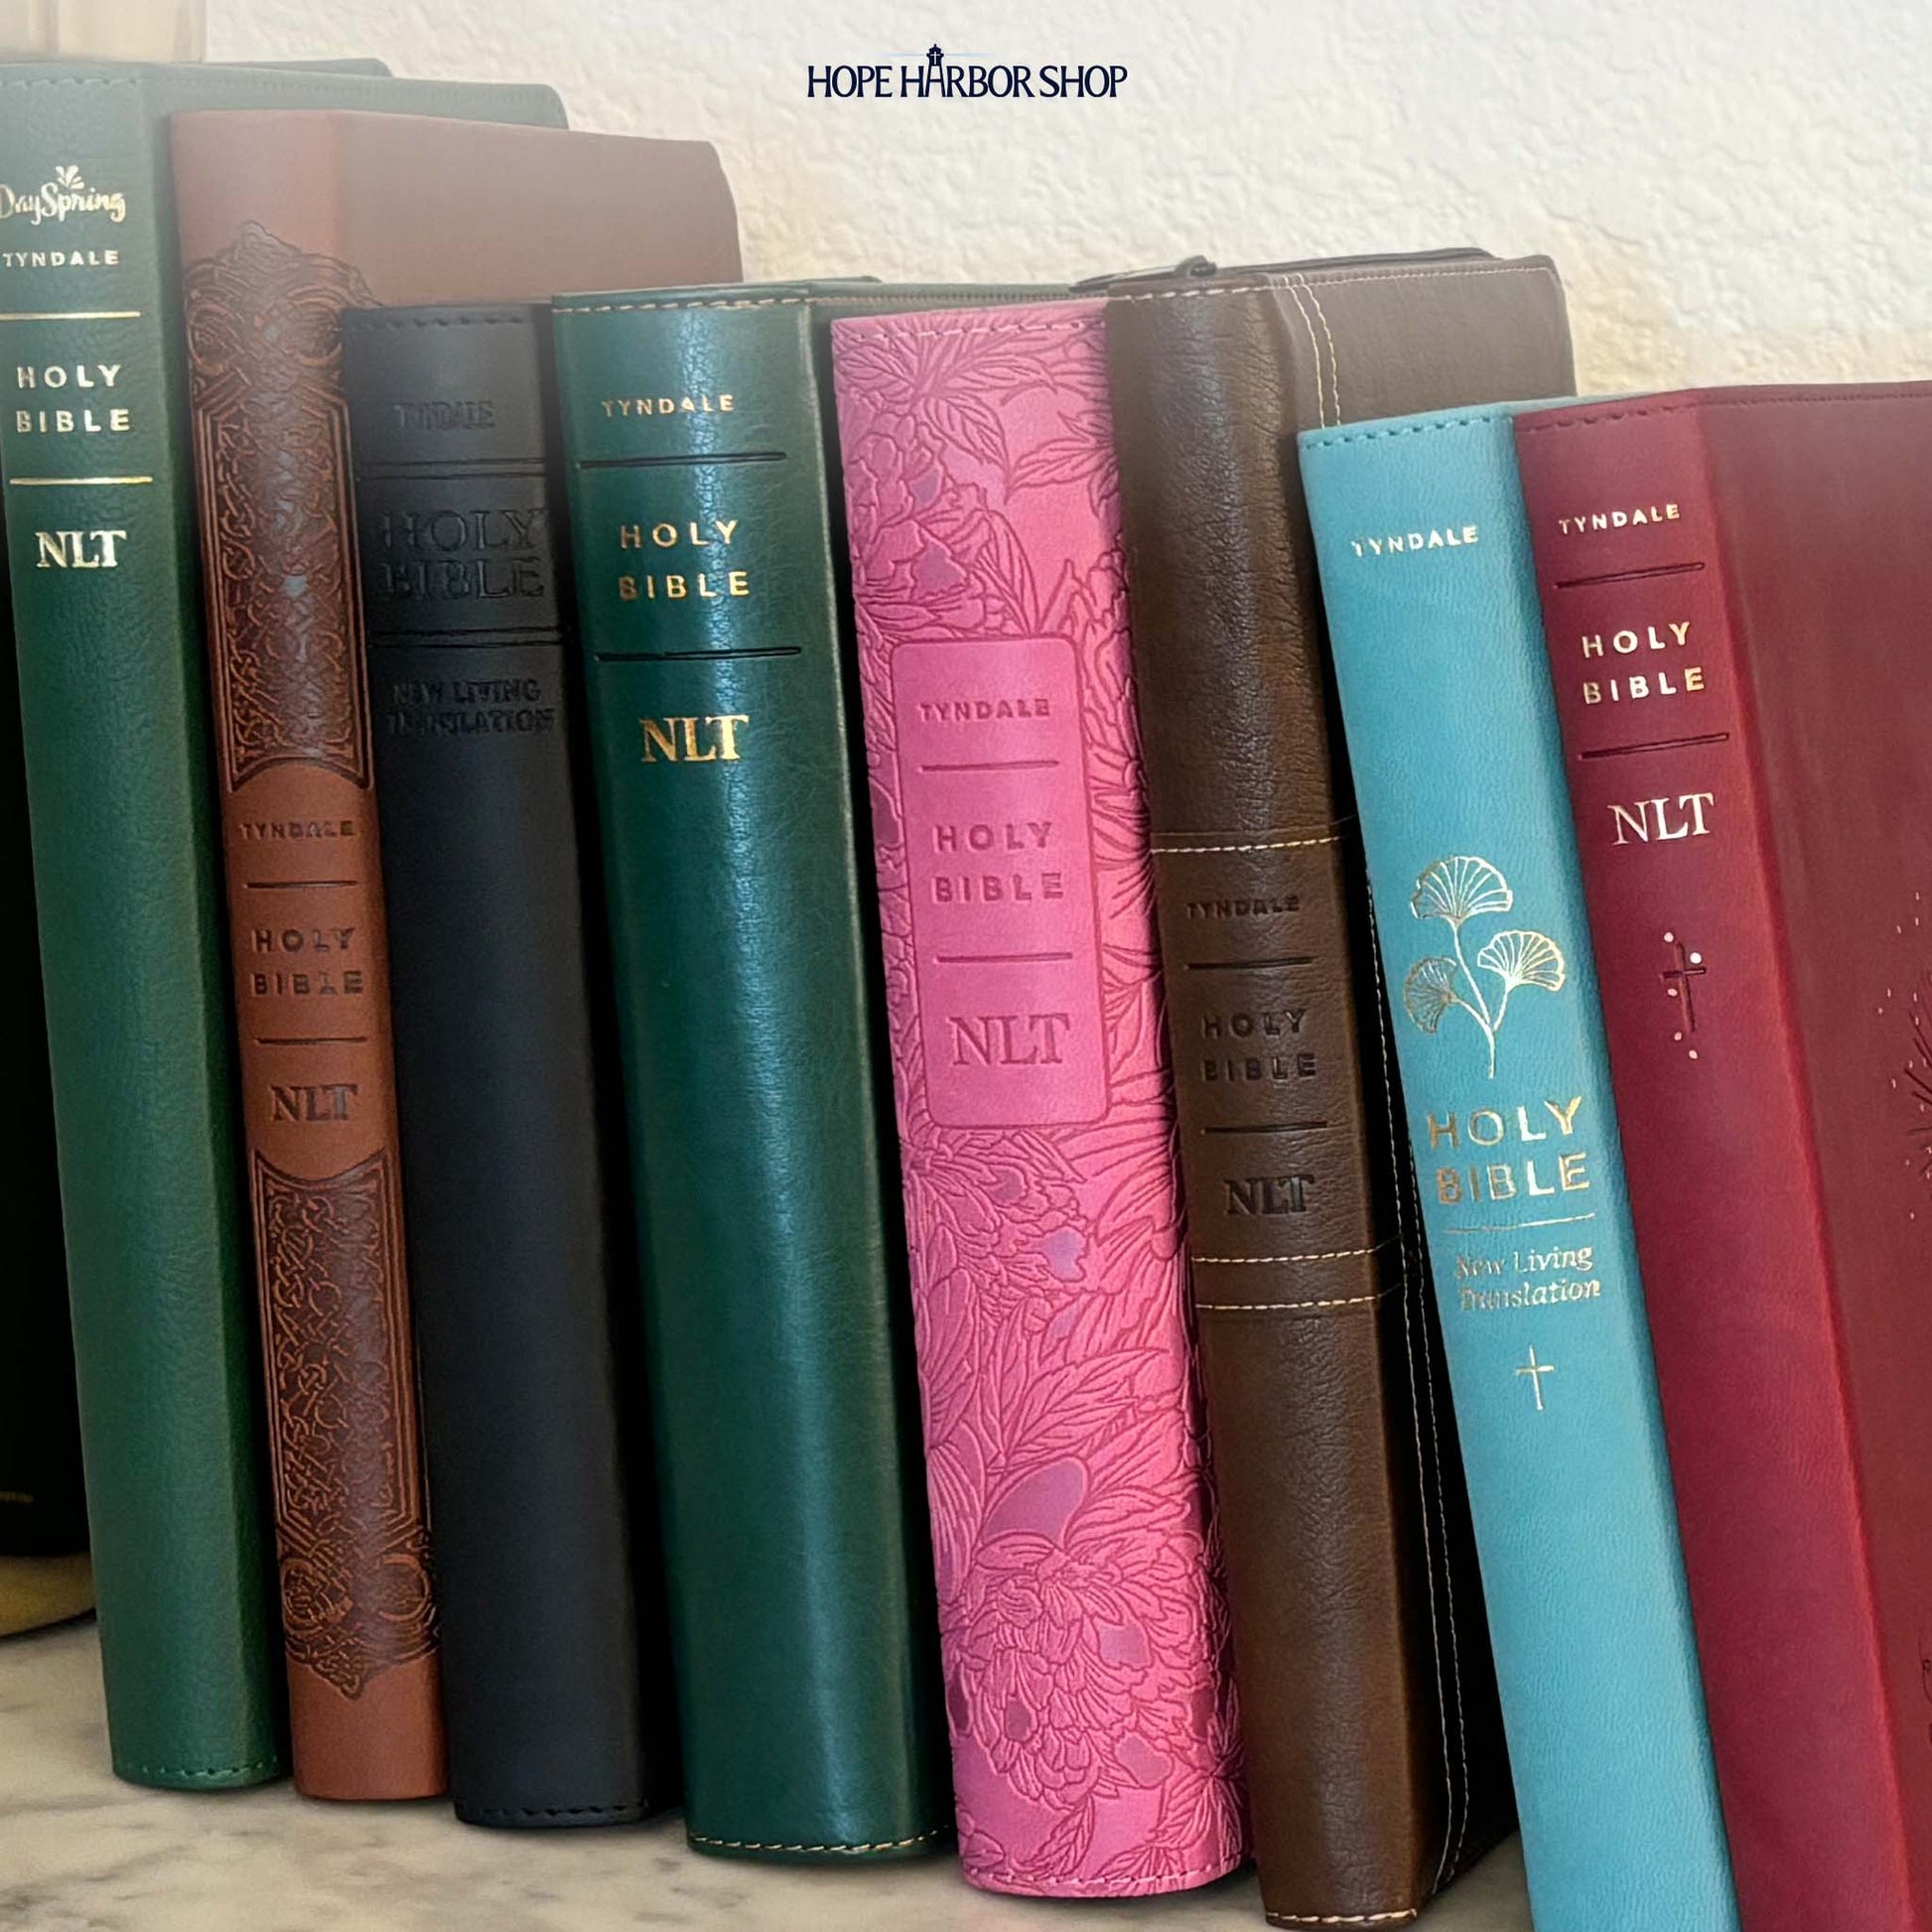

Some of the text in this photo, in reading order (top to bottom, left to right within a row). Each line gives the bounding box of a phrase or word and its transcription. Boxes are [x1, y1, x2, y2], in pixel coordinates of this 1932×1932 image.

[0, 182, 126, 225] DaySpring
[2, 249, 120, 268] TYNDALE
[17, 363, 121, 389] HOLY
[16, 408, 130, 433] BIBLE
[602, 394, 735, 417] TYNDALE
[382, 507, 547, 552] HOLY
[620, 519, 739, 549] HOLY
[1559, 503, 1681, 535] TYNDALE
[35, 529, 127, 568] NLT
[1352, 525, 1479, 557] TYNDALE
[379, 557, 545, 600] BIBLE
[619, 570, 751, 601] BIBLE
[1582, 621, 1690, 658] HOLY
[1583, 667, 1705, 705] BIBLE
[917, 699, 1050, 723] TYNDALE
[639, 714, 750, 762] NLT
[240, 820, 355, 841] TYNDALE
[1607, 792, 1714, 846] NLT
[932, 821, 1053, 854] HOLY
[931, 873, 1064, 902] BIBLE
[1186, 895, 1300, 919] TYNDALE
[251, 928, 355, 953] HOLY
[251, 970, 363, 996] BIBLE
[947, 1013, 1071, 1065] NLT
[1201, 1008, 1308, 1040] HOLY
[1201, 1052, 1317, 1082] BIBLE
[270, 1083, 358, 1122] NLT
[1428, 1096, 1582, 1149] HOLY
[1223, 1173, 1315, 1215] NLT
[1437, 1152, 1590, 1205] BIBLE
[1456, 1246, 1593, 1279] New Living
[1459, 1278, 1601, 1311] Translation
